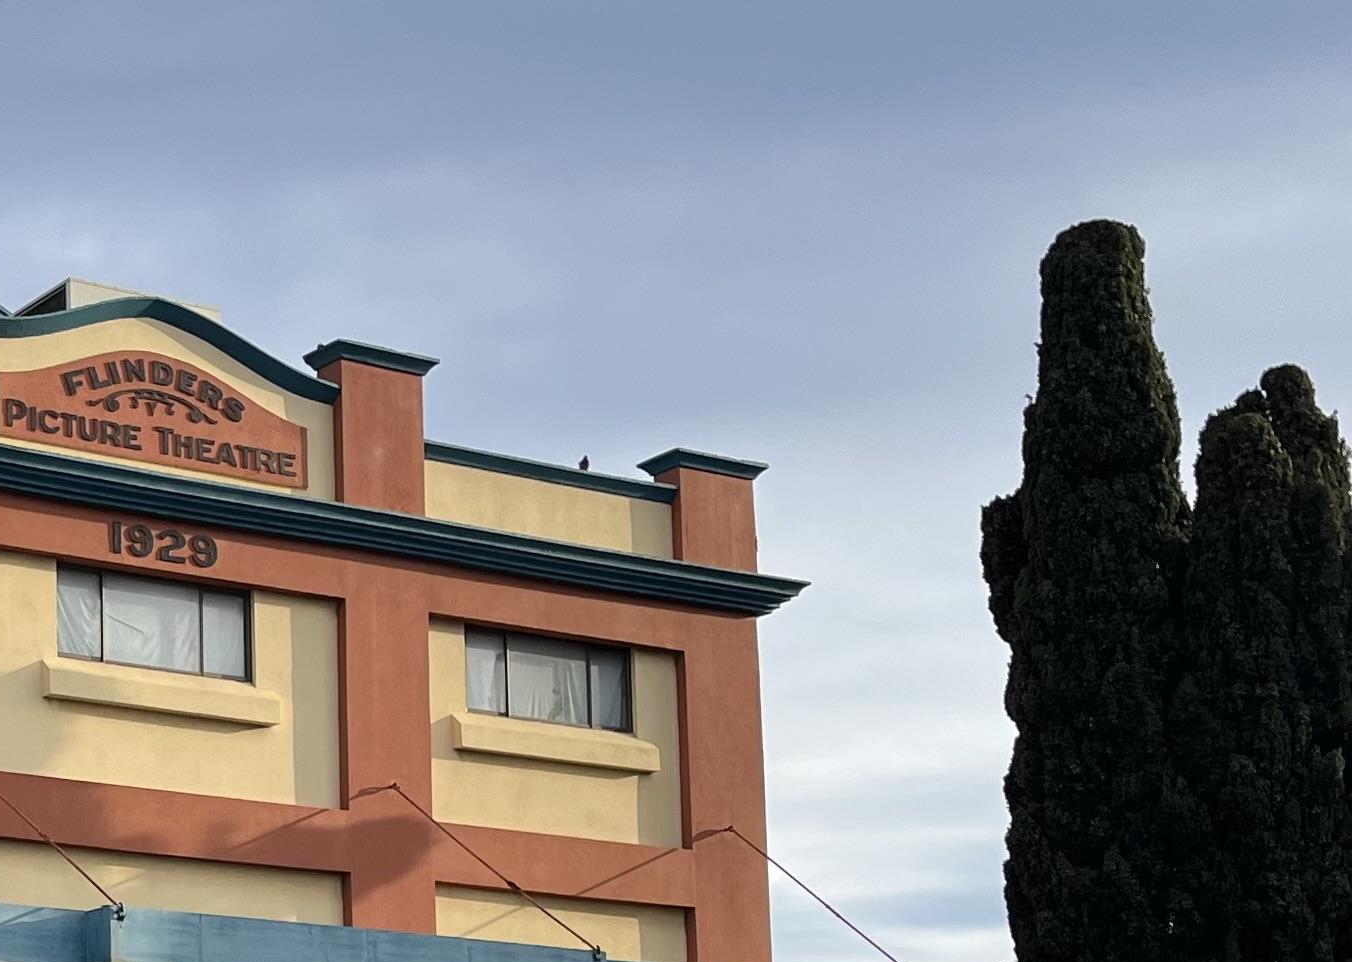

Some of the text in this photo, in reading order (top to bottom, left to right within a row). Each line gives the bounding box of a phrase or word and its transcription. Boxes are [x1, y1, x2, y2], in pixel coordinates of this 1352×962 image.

[59, 358, 246, 423] FLINDERS
[2, 397, 297, 477] PICTURE THEATRE
[108, 520, 219, 568] 1929
